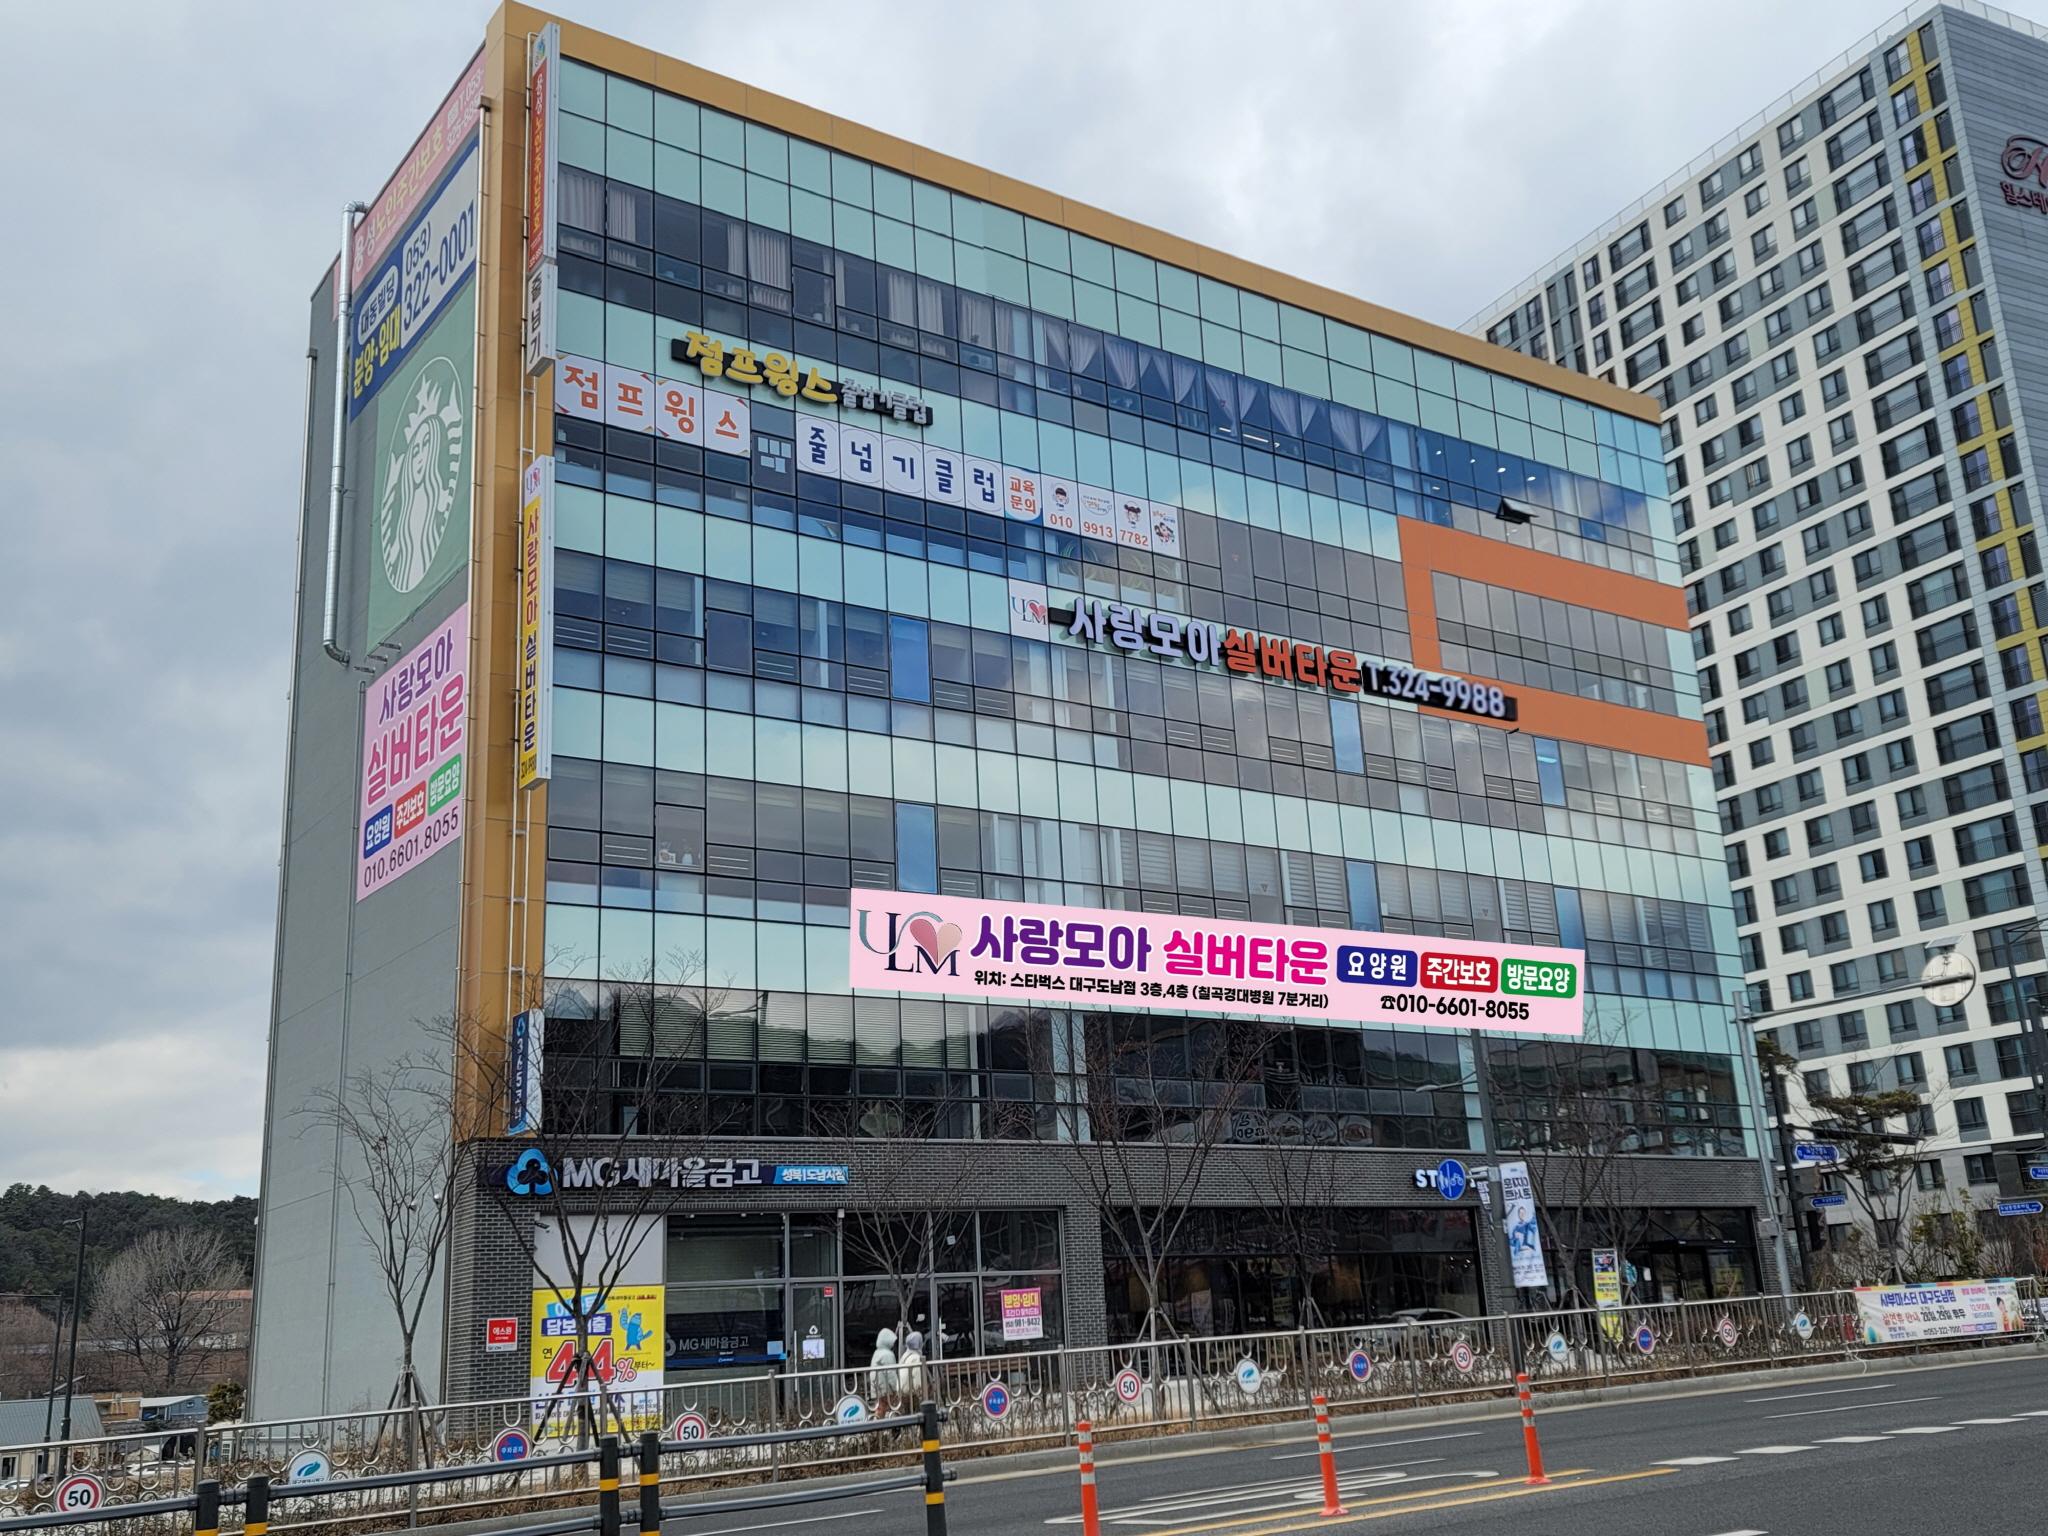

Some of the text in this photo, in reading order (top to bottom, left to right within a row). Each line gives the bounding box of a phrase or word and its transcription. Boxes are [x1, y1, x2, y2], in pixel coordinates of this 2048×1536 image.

[403, 199, 475, 332] 322-0001
[405, 220, 432, 277] 053)
[360, 271, 395, 335] 대동빌딩
[530, 271, 543, 365] 줄넘기
[685, 330, 838, 404] 점프윙스
[564, 364, 740, 441] 점프윙스
[1009, 475, 1036, 497] 교육
[1010, 496, 1037, 516] 문의
[1050, 513, 1149, 547] 010 9913 7782
[526, 507, 538, 626] 사랑모아
[378, 628, 454, 726] 사랑모아
[367, 674, 464, 807] 실버타운
[363, 806, 459, 889] 010.6601.8055
[365, 812, 391, 851] 요양원
[396, 789, 425, 831] 주간보호
[970, 915, 1152, 973] 사랑모아
[1163, 930, 1329, 986] 실버타운
[1426, 957, 1492, 987] 주간보호
[1507, 964, 1571, 994] 방문요양
[974, 970, 1329, 1010] 위치: 스타벅스 대구도남점 3층,4층 (칠곡경대병원 7분거리)
[1396, 993, 1530, 1020] 010-6601-8055
[542, 1347, 553, 1360] 연
[1458, 1351, 1468, 1363] 50
[1724, 1328, 1733, 1338] 50
[1123, 1380, 1136, 1394] 50
[682, 1424, 700, 1440] 50
[67, 1489, 91, 1507] 50
